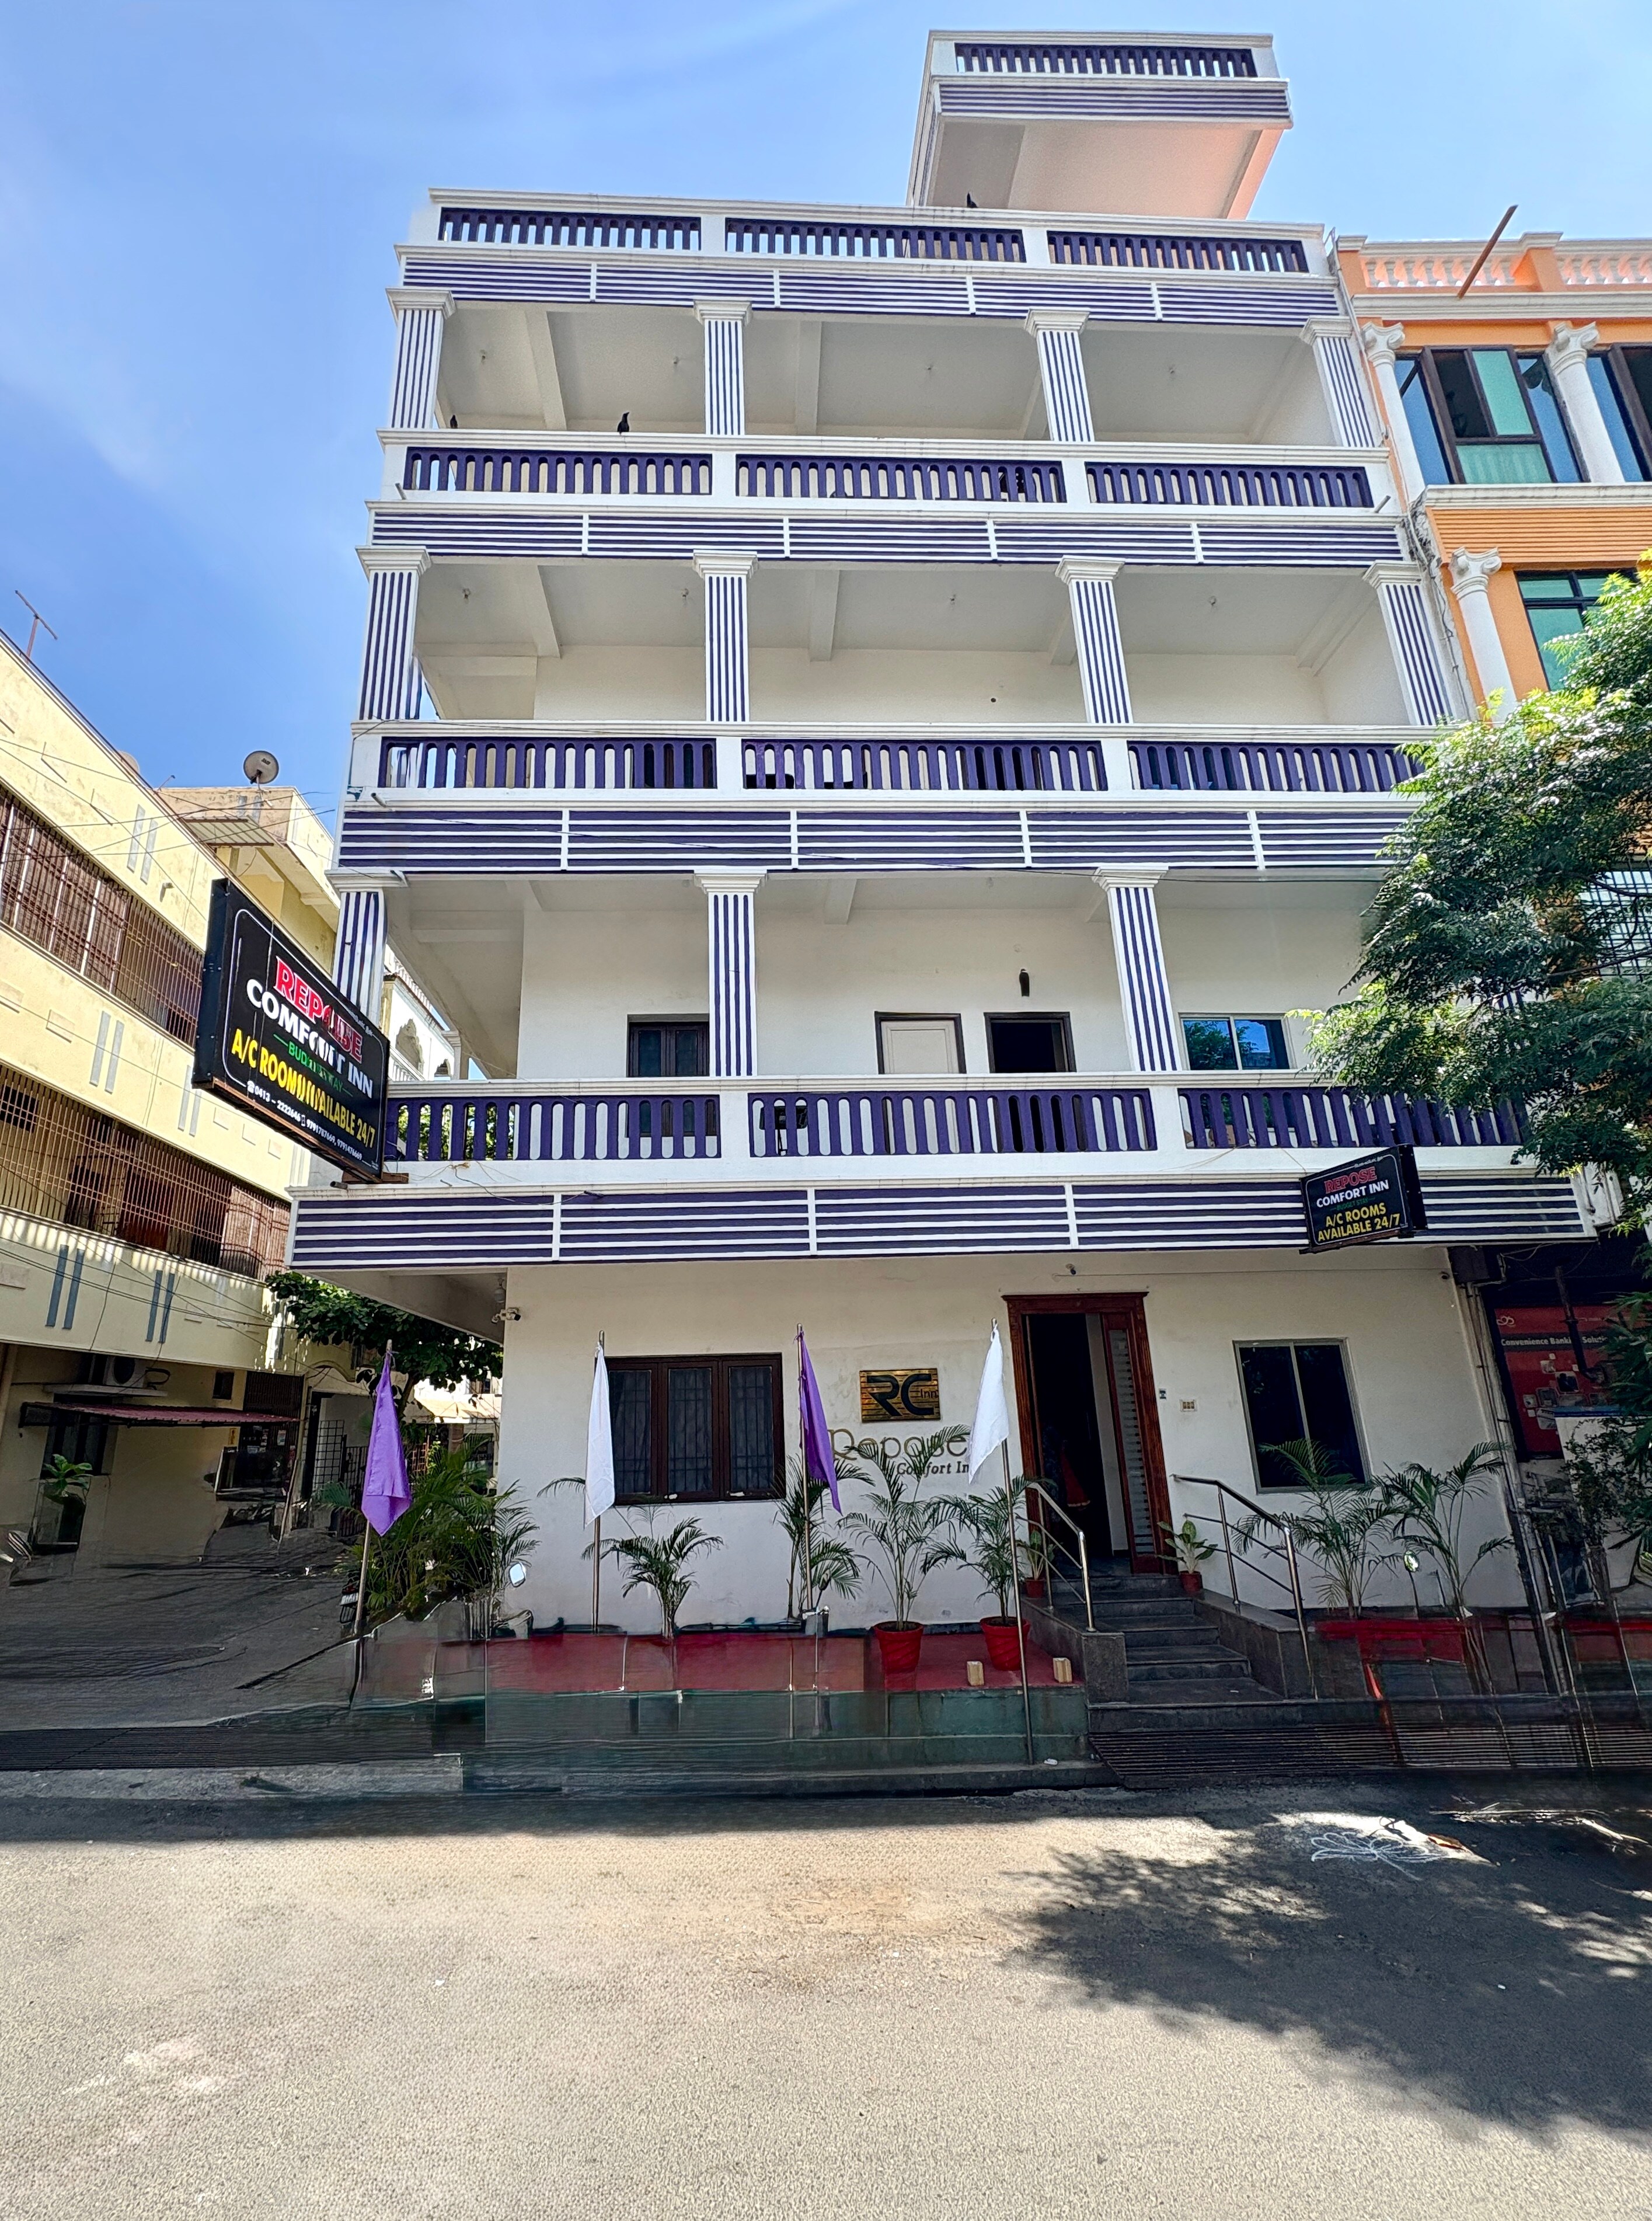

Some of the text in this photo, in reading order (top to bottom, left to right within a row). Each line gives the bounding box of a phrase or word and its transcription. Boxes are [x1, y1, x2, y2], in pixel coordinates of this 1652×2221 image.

[231, 1028, 257, 1069] A/C
[356, 1118, 375, 1148] 24/7
[255, 1085, 270, 1102] 0413
[348, 1061, 374, 1099] INN
[1316, 1179, 1389, 1207] COMFORT INN
[1324, 1167, 1377, 1194] REPOSE
[1326, 1202, 1386, 1227] A/C ROOMS
[1337, 1197, 1368, 1210] BUDGET STAY
[1318, 1213, 1400, 1241] AVAILABLE 24/7
[1501, 1338, 1549, 1346] Convenience
[1549, 1336, 1572, 1345] Banki
[867, 1373, 938, 1416] RC Inn
[897, 1461, 951, 1478] Cofort
